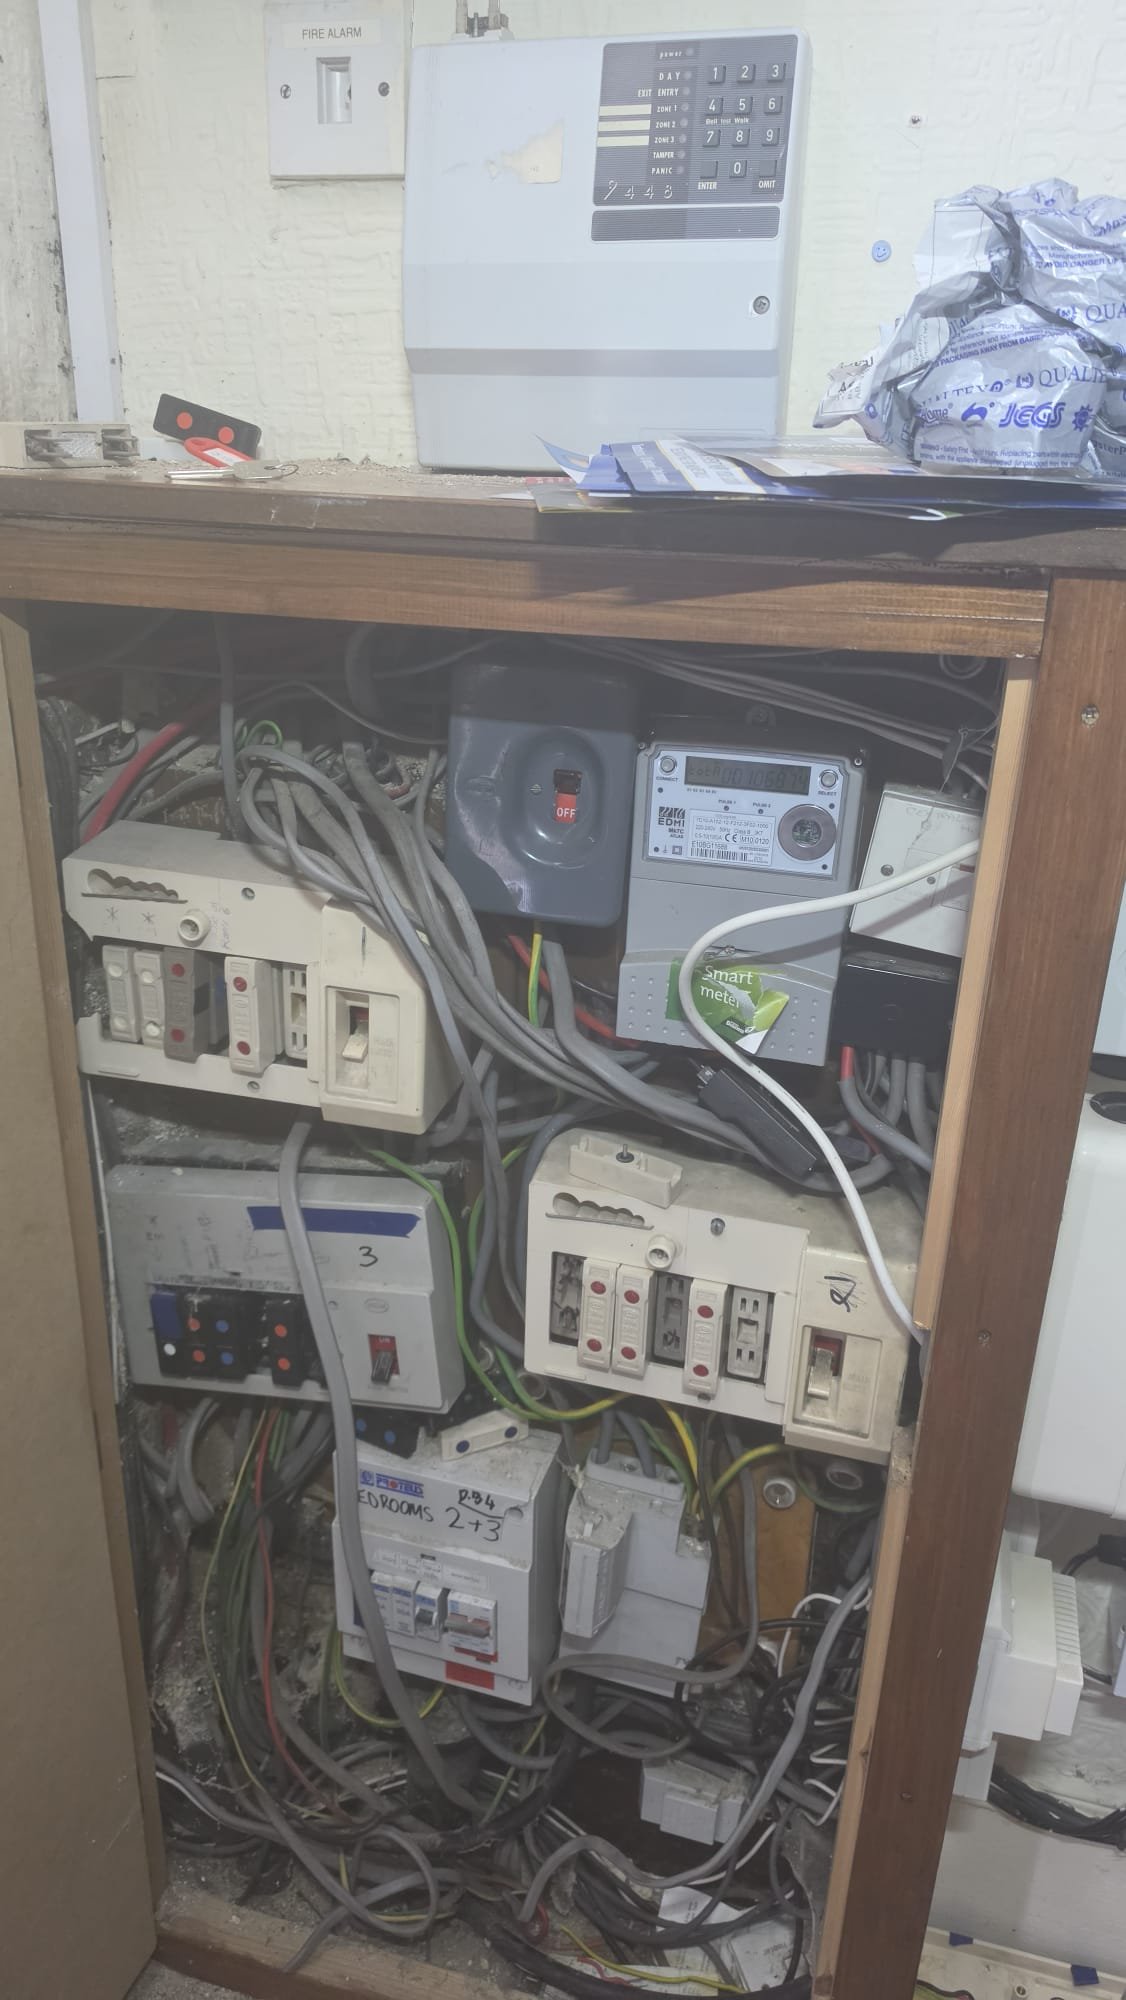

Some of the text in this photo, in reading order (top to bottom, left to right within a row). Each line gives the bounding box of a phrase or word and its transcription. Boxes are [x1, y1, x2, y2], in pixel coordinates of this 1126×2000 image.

[302, 26, 362, 40] FIRE ALARM
[659, 50, 682, 59] power
[659, 72, 681, 81] DAY
[713, 65, 779, 79] 1 2 3
[638, 88, 679, 97] EXIT ENTRY
[657, 105, 672, 113] ZONE
[709, 97, 776, 111] 4 5 6
[655, 121, 670, 129] ZONE
[654, 136, 669, 144] ZONE
[706, 129, 773, 143] 7 8 9
[653, 151, 674, 159] TAMPER
[651, 167, 673, 175] PANIC
[734, 162, 741, 175] 0
[698, 181, 717, 190] ENTER
[759, 180, 776, 189] OMIT
[980, 344, 998, 356] AWAY
[998, 338, 1019, 349] FROM
[999, 401, 1066, 428] JEGS
[556, 807, 577, 819] OFF
[658, 817, 685, 827] EDMI
[705, 965, 753, 985] Smart
[359, 1246, 378, 1267] 3
[358, 1490, 434, 1522] EDROOMS
